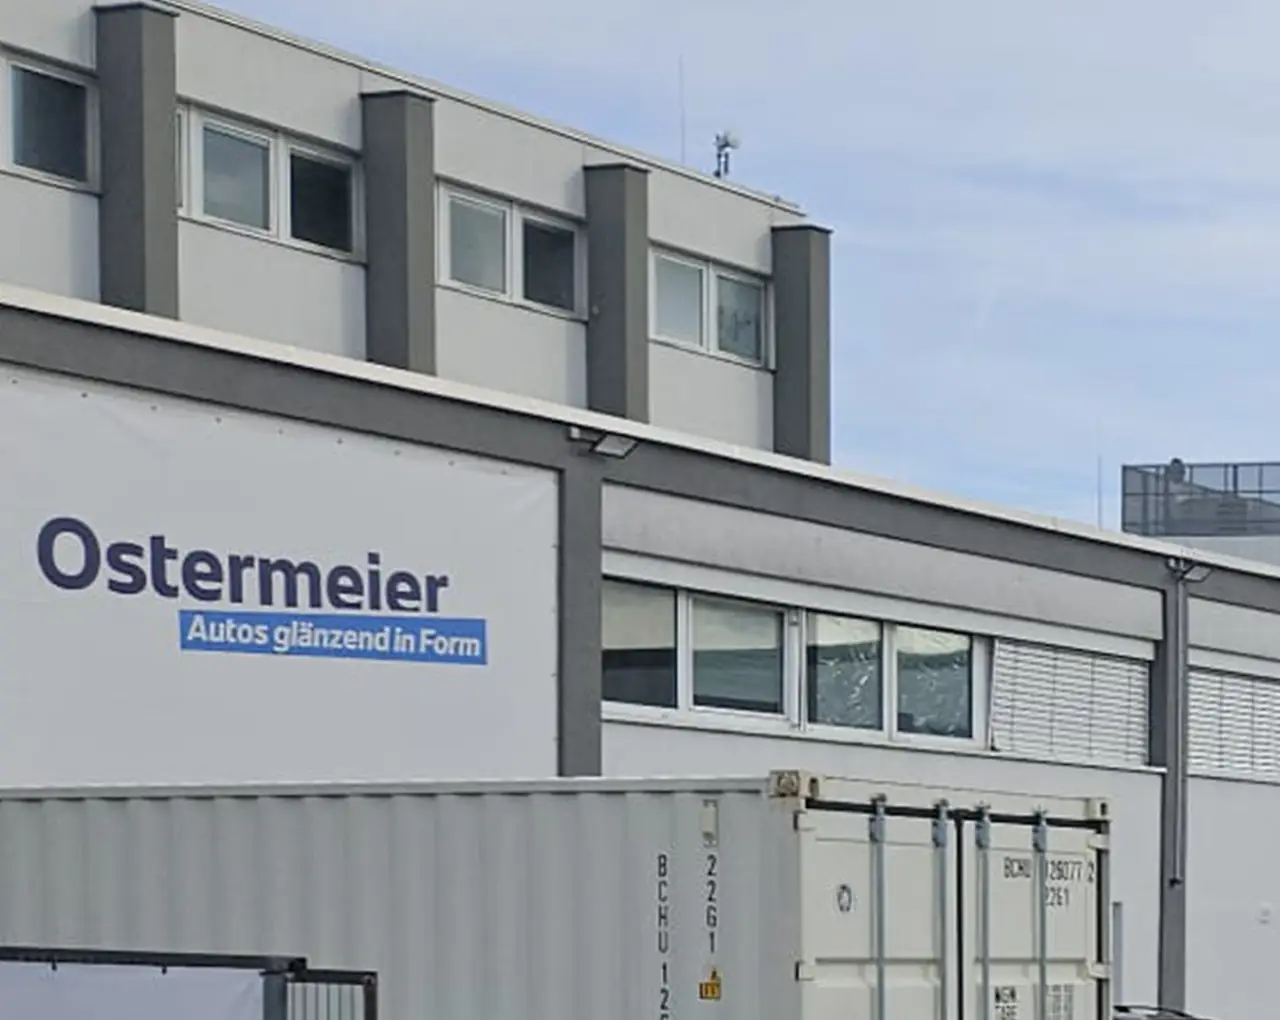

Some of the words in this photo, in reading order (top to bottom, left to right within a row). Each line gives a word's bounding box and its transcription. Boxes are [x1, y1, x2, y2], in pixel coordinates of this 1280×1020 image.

[37, 516, 449, 613] Ostermeier
[187, 615, 269, 643] Autos
[273, 620, 390, 652] glänzend
[395, 626, 415, 652] in
[419, 628, 481, 657] Form
